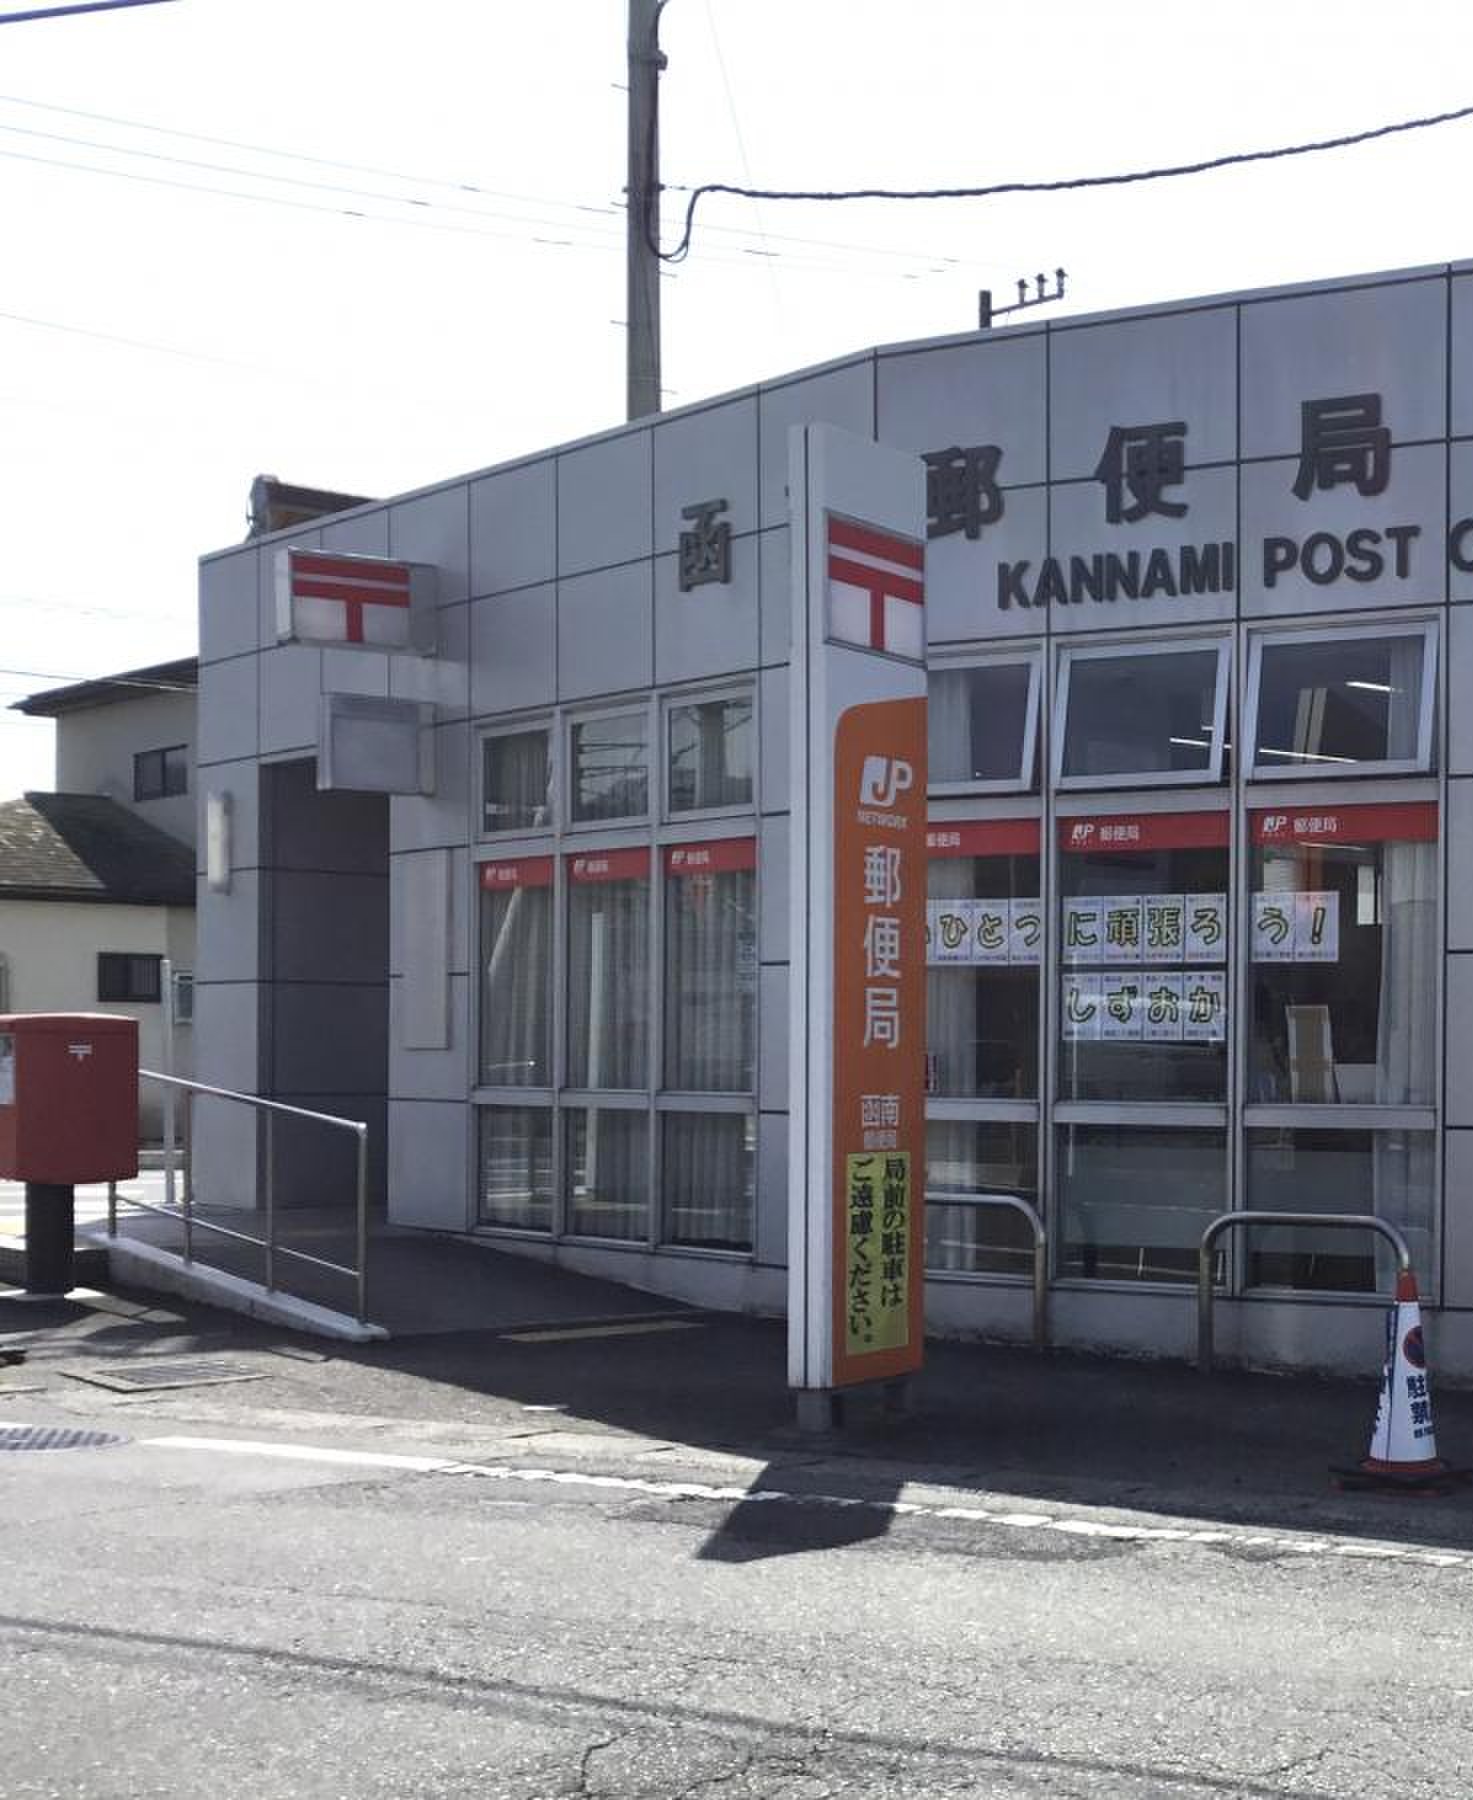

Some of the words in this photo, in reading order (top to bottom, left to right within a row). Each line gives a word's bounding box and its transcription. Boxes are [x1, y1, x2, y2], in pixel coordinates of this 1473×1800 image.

[997, 541, 1235, 610] KANNAMI
[1262, 525, 1421, 588] POST
[862, 846, 902, 1049] 郵便局
[927, 912, 1041, 949] ひとつ
[1067, 984, 1222, 1024] しずおか
[881, 1158, 906, 1308] 局前の駐車は
